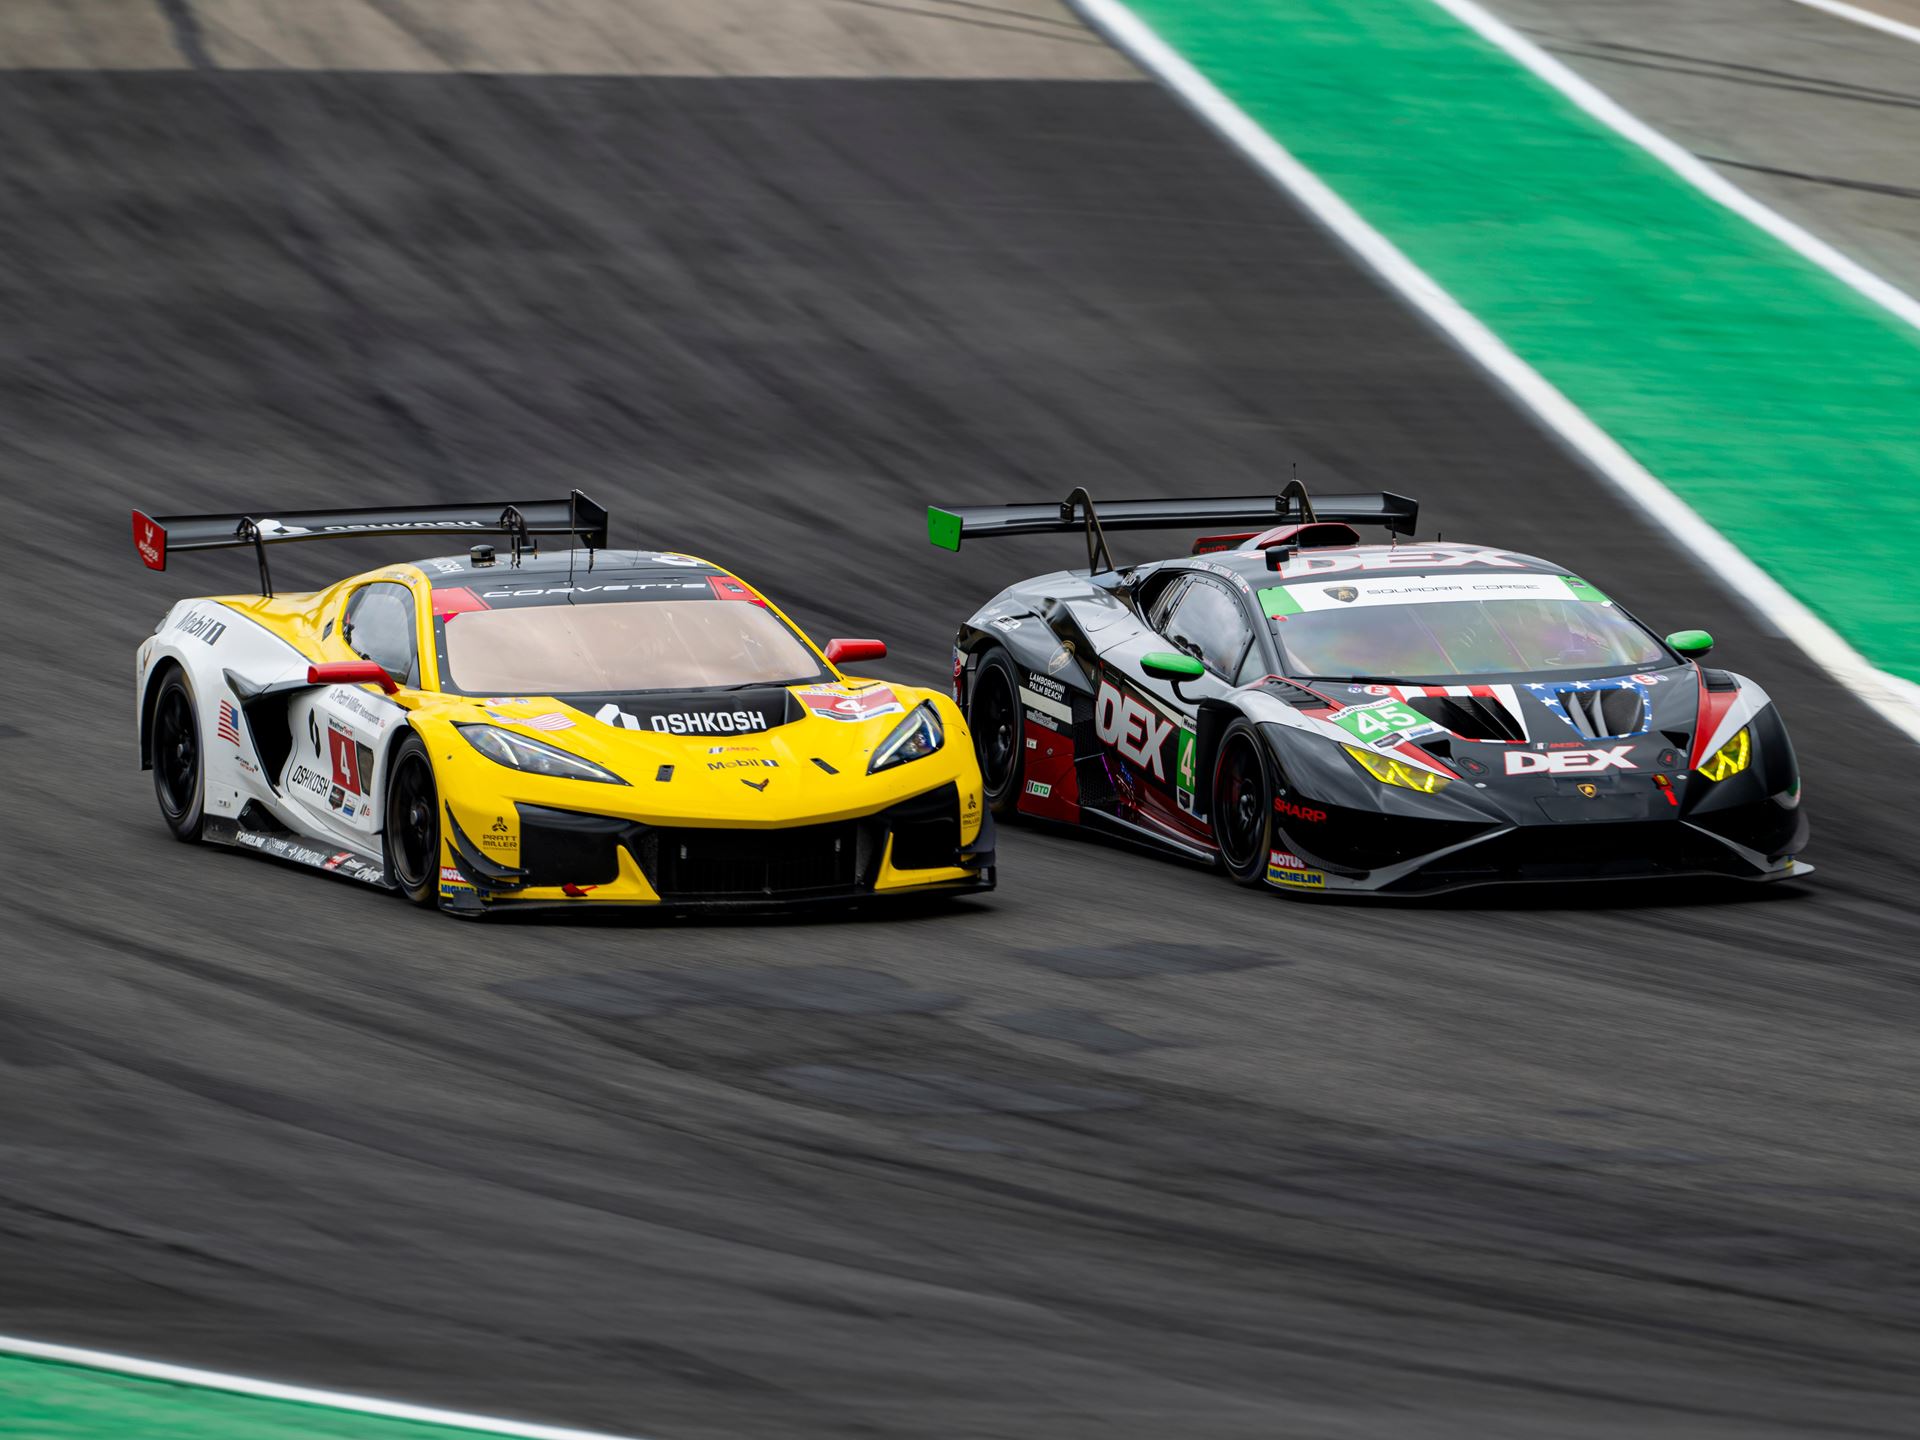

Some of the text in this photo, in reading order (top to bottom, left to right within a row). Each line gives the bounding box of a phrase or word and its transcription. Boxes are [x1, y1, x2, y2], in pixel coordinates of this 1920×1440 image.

[1280, 550, 1527, 579] DEX
[482, 583, 707, 598] CORVETTE
[1366, 583, 1540, 595] SQUADRA CORSE
[174, 610, 224, 644] Mobil 1
[1028, 681, 1063, 702] PALM BEACH
[1029, 672, 1066, 693] LAMBORGHINI
[835, 699, 867, 713] 4
[650, 711, 767, 734] OSHKOSH
[1095, 678, 1175, 783] DEX
[1356, 706, 1417, 736] 45
[340, 741, 352, 785] 4
[707, 759, 760, 771] Mobil
[1181, 737, 1196, 788] 4
[1504, 745, 1640, 776] DEX
[292, 765, 331, 798] OSHKOSH
[1033, 784, 1050, 795] GTD
[1274, 797, 1328, 823] SHARP
[1269, 868, 1322, 885] MICHELIN
